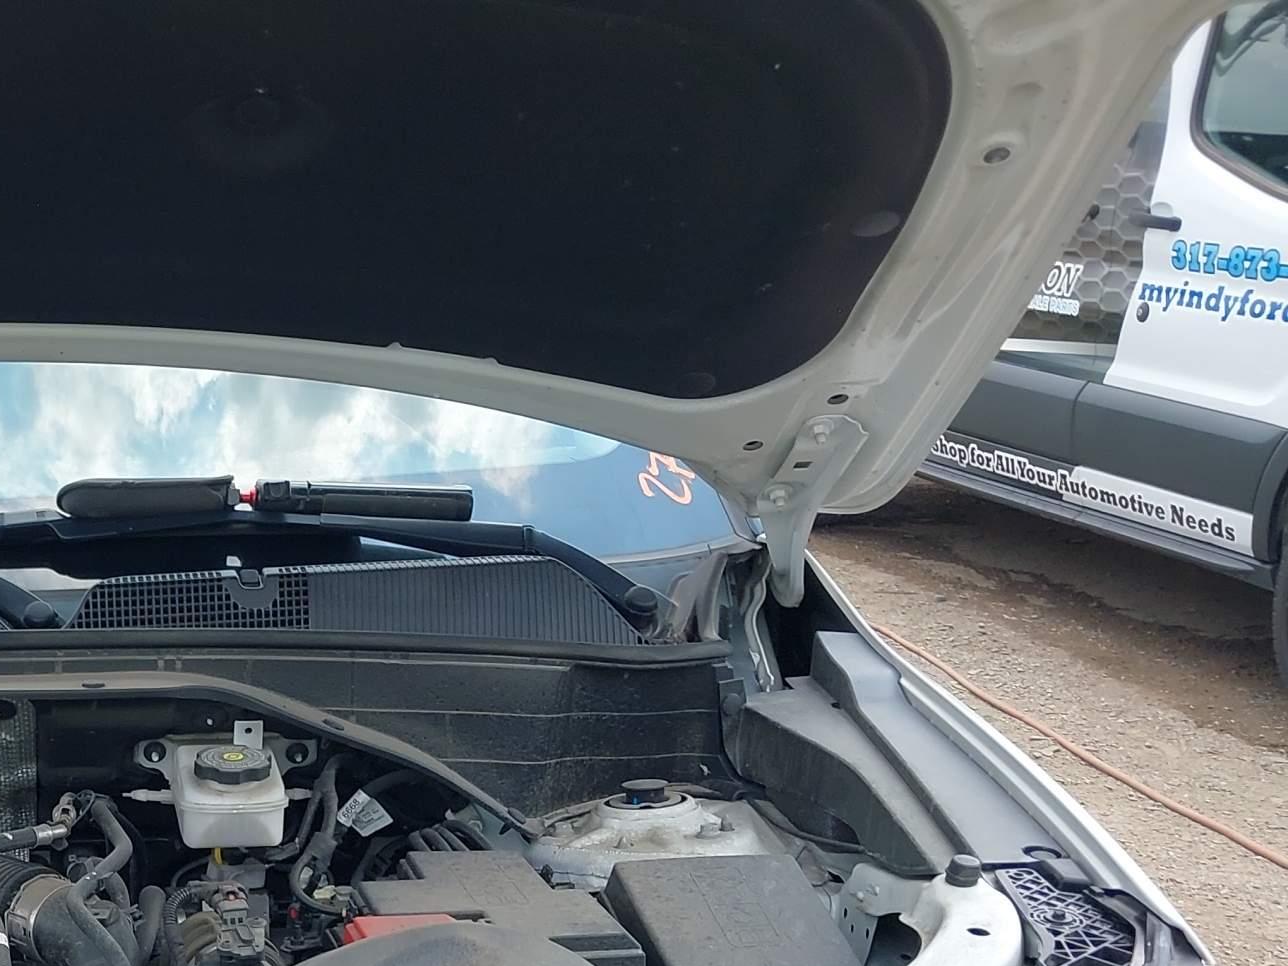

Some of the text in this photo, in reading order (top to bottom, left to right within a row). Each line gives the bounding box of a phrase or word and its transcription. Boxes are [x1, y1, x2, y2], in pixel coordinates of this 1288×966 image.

[969, 445, 994, 470] for
[995, 451, 1017, 478] All
[1016, 458, 1056, 490] Your
[1058, 471, 1166, 521] Automotive
[1170, 503, 1237, 543] Needs
